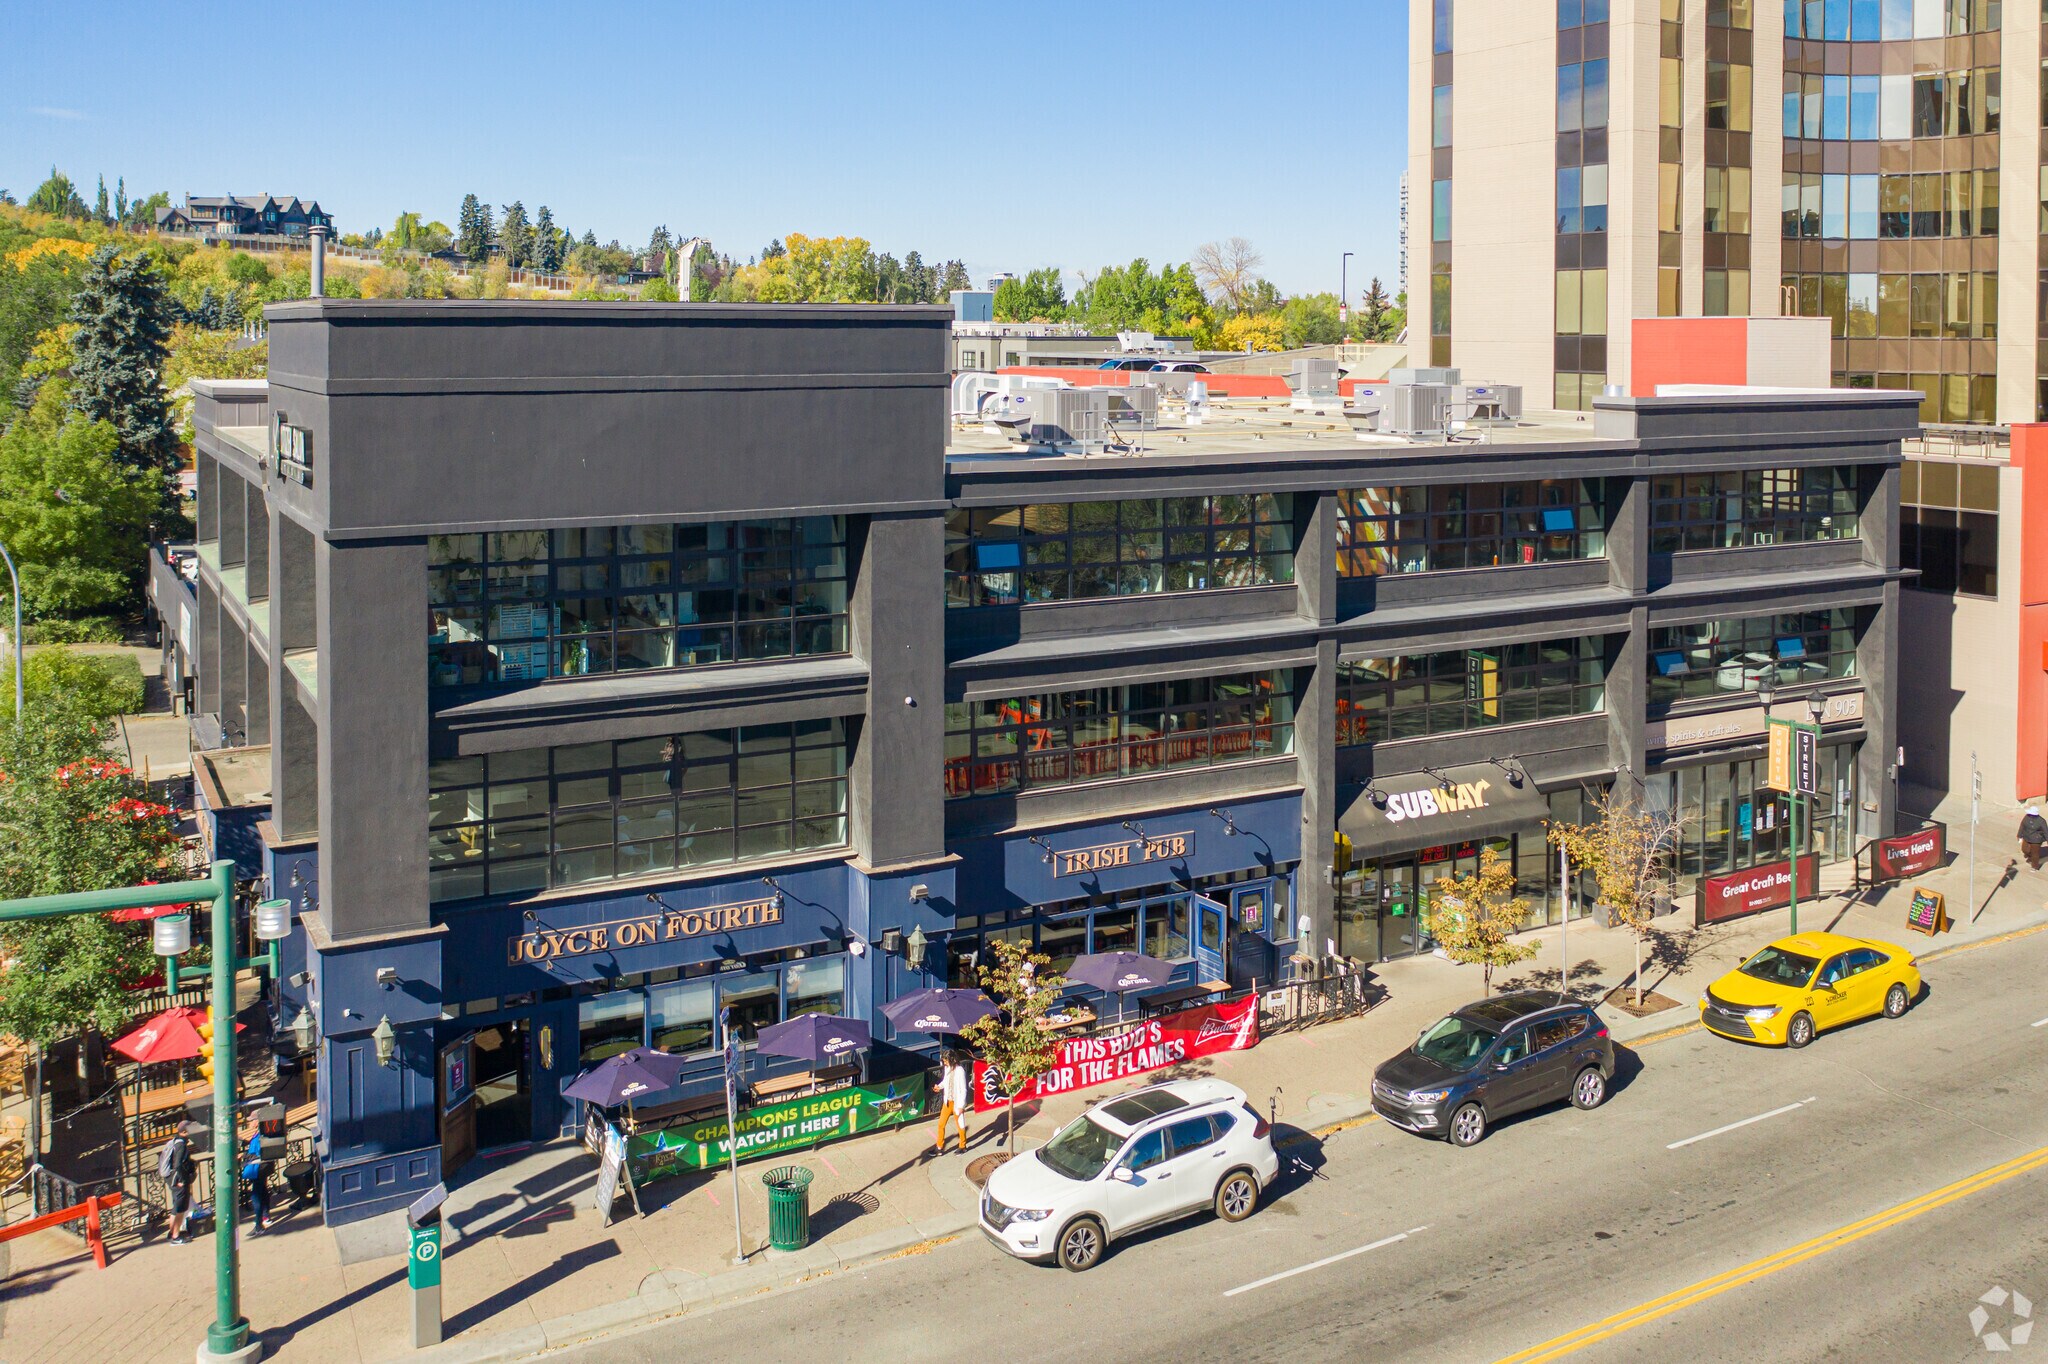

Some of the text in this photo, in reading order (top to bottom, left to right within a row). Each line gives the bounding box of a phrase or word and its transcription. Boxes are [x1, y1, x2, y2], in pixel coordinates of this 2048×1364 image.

[1806, 698, 1857, 721] BN 905
[1670, 729, 1696, 744] spirits
[1697, 727, 1705, 738] &
[1707, 724, 1725, 736] craft
[1725, 723, 1742, 734] ales
[1385, 779, 1491, 824] SUBWAY
[1065, 837, 1187, 874] IRISH PUB
[1887, 839, 1934, 860] Lives Here!
[1722, 877, 1749, 898] Great
[1751, 871, 1775, 892] Craft
[510, 901, 782, 962] JOYCE ON FOURTH
[1065, 1021, 1162, 1065] THIS BUD'S
[1036, 1038, 1185, 1095] FOR THE FLAMES
[694, 1093, 862, 1142] CHAMPIONS LEAGUE
[718, 1114, 840, 1153] WATCH IT HERE
[422, 1245, 433, 1258] P
